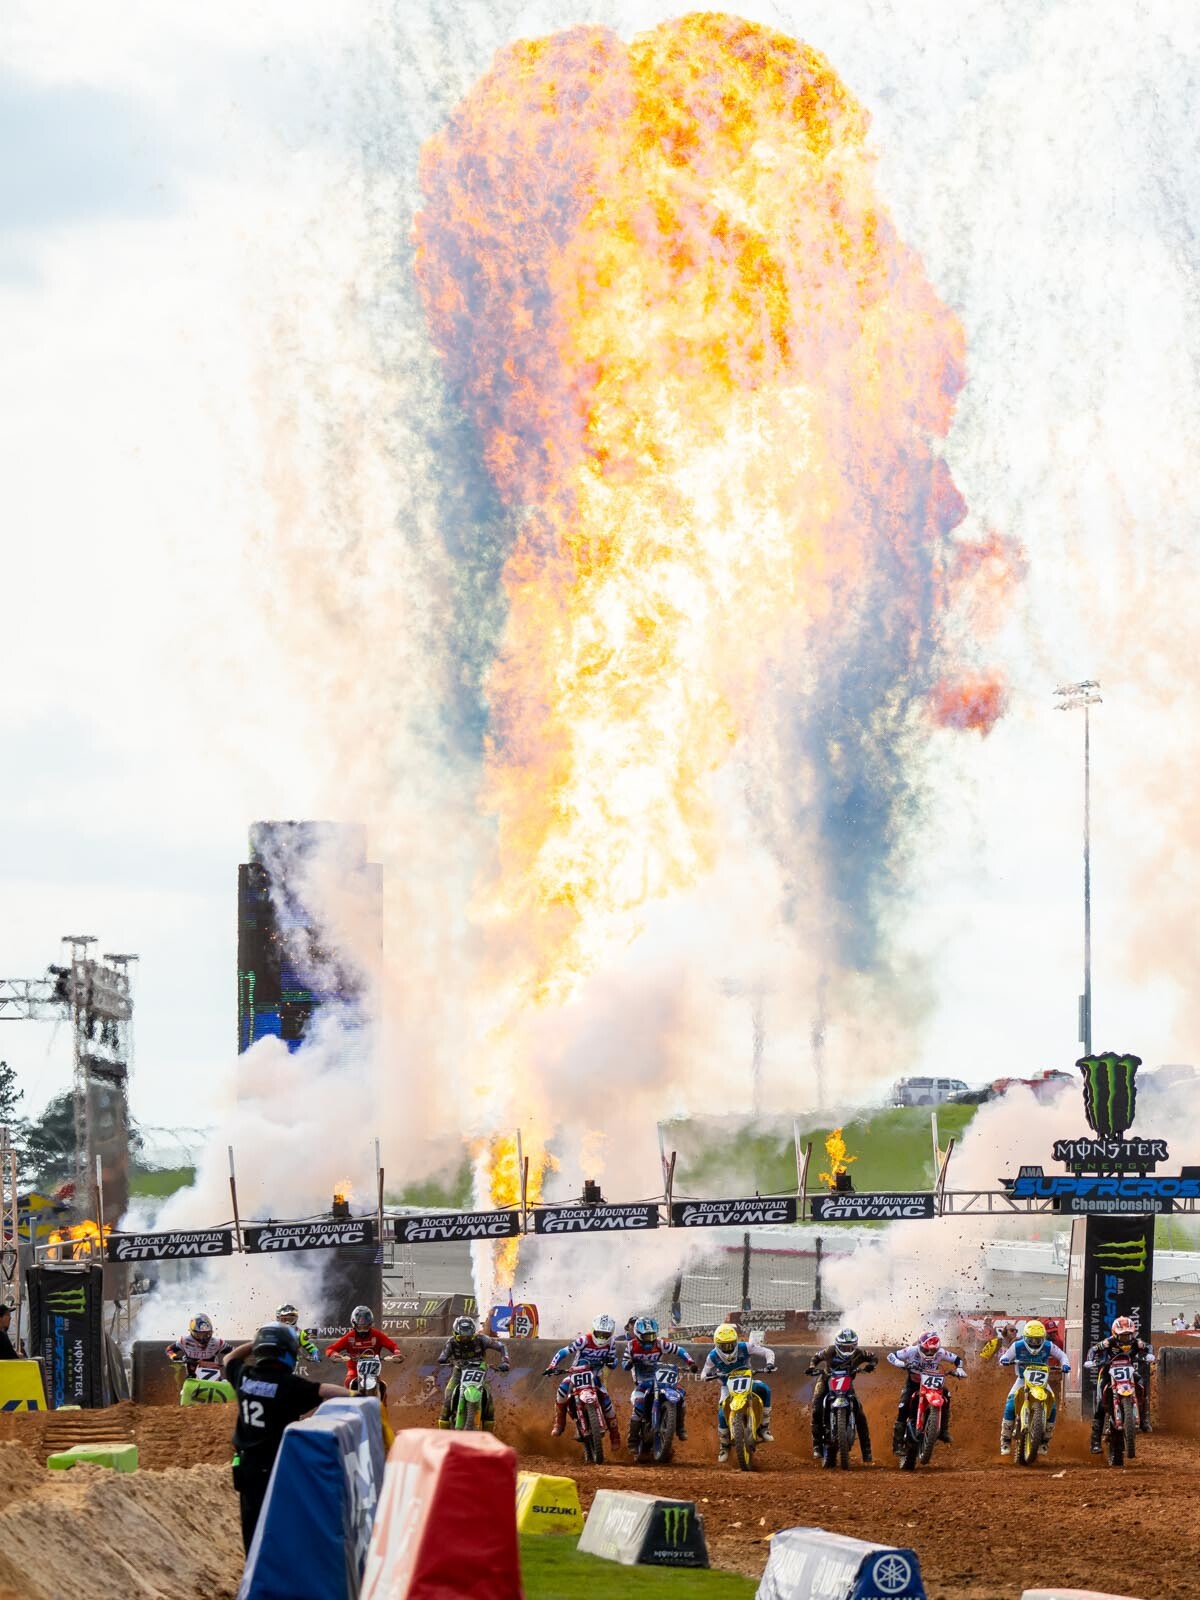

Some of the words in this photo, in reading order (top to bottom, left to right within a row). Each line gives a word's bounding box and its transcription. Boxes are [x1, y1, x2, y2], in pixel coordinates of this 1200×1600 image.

[1056, 1139, 1168, 1159] MONSTER
[1075, 1161, 1149, 1170] ENERGY
[1020, 1168, 1043, 1177] AMA
[699, 1203, 731, 1212] ROCKY
[733, 1201, 787, 1210] MOUNTAIN
[837, 1197, 869, 1205] ROCKY
[872, 1196, 925, 1205] MOUNTAIN
[1071, 1198, 1162, 1214] Championship
[559, 1209, 592, 1218] ROCKY
[593, 1207, 648, 1216] MOUNTAIN
[422, 1218, 453, 1227] ROCKY
[456, 1214, 510, 1224] MOUNTAIN
[275, 1227, 308, 1236] ROCKY
[310, 1222, 364, 1234] MOUNTAIN
[134, 1236, 165, 1246] ROCKY
[168, 1233, 224, 1243] MOUNTAIN
[383, 1302, 420, 1310] NSTER
[318, 1325, 353, 1336] MONST
[382, 1320, 410, 1330] STER
[516, 1317, 528, 1335] 519
[73, 1339, 84, 1397] MONSTER
[358, 1362, 380, 1375] 412
[1114, 1367, 1131, 1380] 51
[200, 1369, 218, 1380] 7
[463, 1371, 484, 1382] 68
[574, 1374, 591, 1386] 60
[658, 1371, 678, 1384] 78
[1029, 1371, 1046, 1384] 12
[732, 1378, 747, 1391] 11
[836, 1378, 846, 1389] 1
[924, 1376, 943, 1389] 45
[242, 1398, 266, 1428] 12
[532, 1506, 576, 1516] SUZUKI
[654, 1550, 695, 1558] MONSTER
